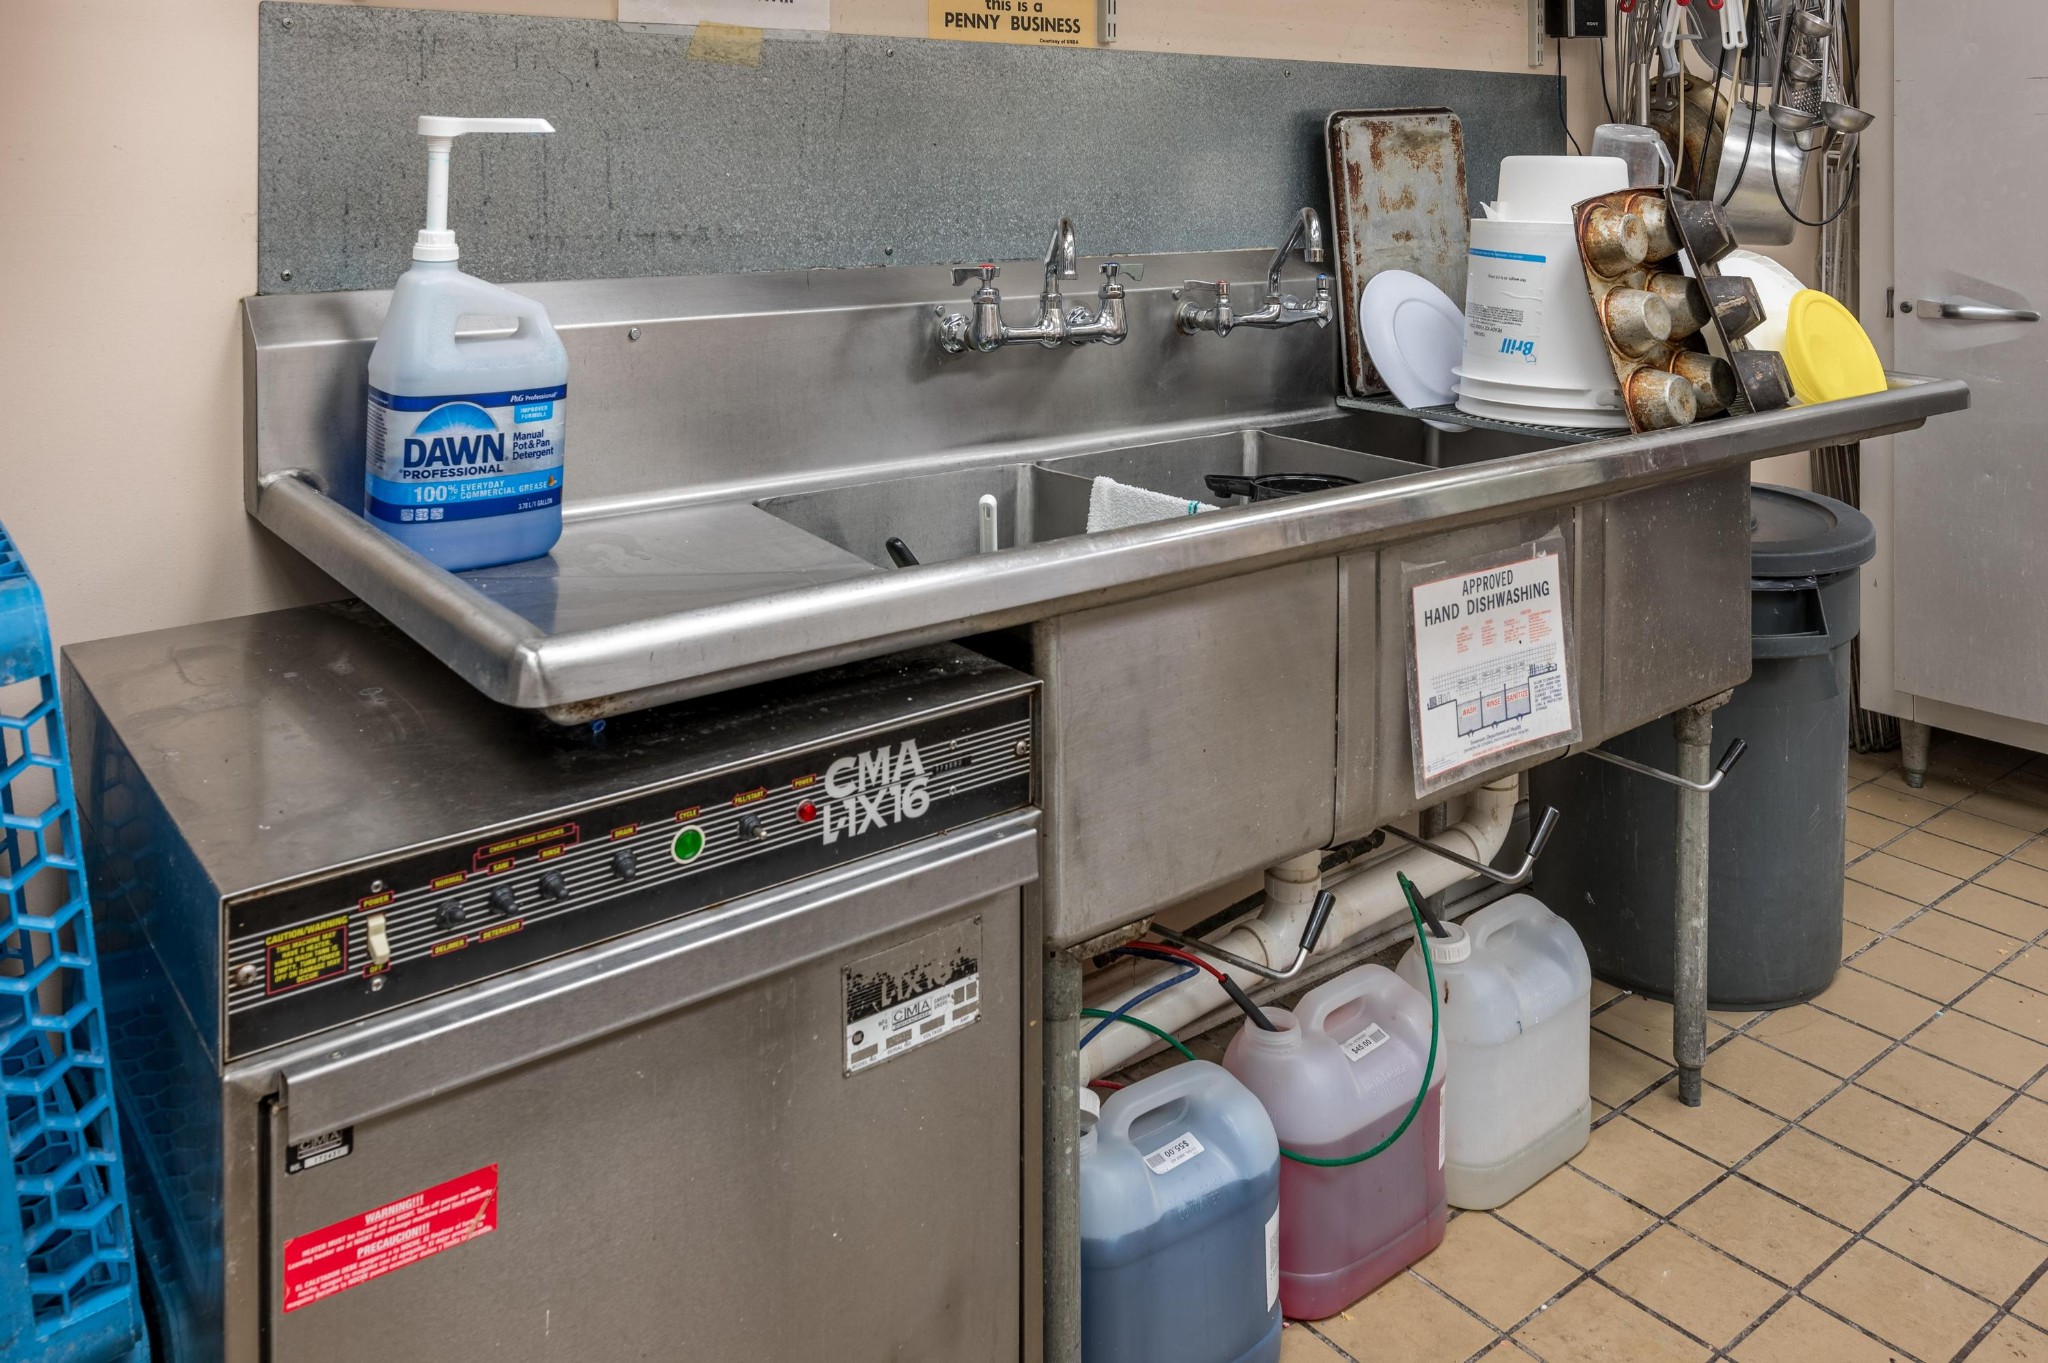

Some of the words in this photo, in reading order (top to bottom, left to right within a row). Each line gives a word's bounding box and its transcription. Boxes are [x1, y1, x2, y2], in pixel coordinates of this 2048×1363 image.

[985, 0, 1011, 11] this
[1018, 0, 1028, 12] is
[1034, 2, 1043, 12] a
[944, 12, 1000, 29] PENNY
[1011, 16, 1081, 33] BUSINESS
[1500, 338, 1534, 356] Brill
[520, 404, 548, 414] IMPROVED
[521, 412, 547, 420] FORMULA
[513, 429, 544, 442] Manual
[403, 434, 504, 468] DAWN
[512, 447, 554, 460] Detergent
[402, 464, 503, 479] PROFESSIONAL
[460, 480, 505, 492] EVERYDAY
[460, 488, 516, 500] COMMERCIAL
[519, 482, 548, 492] GREASE
[537, 498, 552, 507] GALLON
[1462, 570, 1513, 596] APPROVED
[1424, 603, 1459, 627] HAND
[1467, 581, 1550, 615] DISHWASHING
[1486, 698, 1501, 708] RINSE
[1506, 690, 1528, 702] SANITIZE
[1462, 706, 1477, 716] WASH
[825, 738, 926, 799] CMA
[795, 776, 813, 787] POWER
[734, 790, 764, 804] FILL/START
[679, 808, 697, 820] CYCLE
[614, 826, 634, 838] DRAIN
[489, 840, 517, 854] CHEMICAL
[518, 836, 536, 846] PRIME
[537, 828, 564, 841] SWITCHES
[542, 846, 561, 858] RINSE
[493, 861, 510, 872] SANI
[434, 874, 464, 888] NORMAL
[364, 894, 390, 908] POWER
[266, 915, 347, 945] CAUTION/WARNING
[482, 922, 520, 940] DETERGENT
[276, 944, 289, 952] THIS
[292, 936, 319, 948] MACHINE
[322, 931, 335, 939] MAY
[434, 939, 464, 954] DELIMER
[274, 958, 292, 967] WHEN
[295, 952, 312, 961] WASH
[315, 947, 329, 956] TANK
[282, 949, 297, 958] HAVE
[300, 958, 315, 967] TURN
[318, 951, 340, 962] POWER
[275, 974, 286, 982] OFF
[299, 963, 324, 974] DAMAGE
[327, 958, 340, 966] MAY
[370, 964, 383, 974] OFF
[893, 1000, 930, 1022] CMA
[923, 1028, 942, 1040] VOLTAGE
[888, 1046, 903, 1055] SERIAL
[1352, 1039, 1372, 1054] $45.00
[852, 1059, 868, 1070] MODEL
[300, 1131, 341, 1150] CMA
[1164, 1140, 1189, 1158] $55.00
[365, 1194, 423, 1224] WARNING!!!
[302, 1243, 325, 1257] HEATER
[328, 1236, 345, 1247] MUST
[347, 1232, 354, 1240] be
[357, 1224, 377, 1236] turned
[379, 1220, 387, 1228] off
[416, 1204, 429, 1214] Turn
[431, 1200, 439, 1209] off
[440, 1194, 458, 1206] power
[288, 1256, 312, 1271] Leaving
[314, 1248, 334, 1260] heater
[336, 1244, 344, 1252] on
[354, 1234, 372, 1245] NIGHT
[374, 1229, 385, 1238] will
[387, 1219, 410, 1233] damage
[412, 1209, 437, 1223] machine
[439, 1205, 450, 1213] and
[452, 1199, 464, 1208] limit
[357, 1222, 429, 1257] PRECAUCION!!!
[341, 1263, 357, 1274] DEBE
